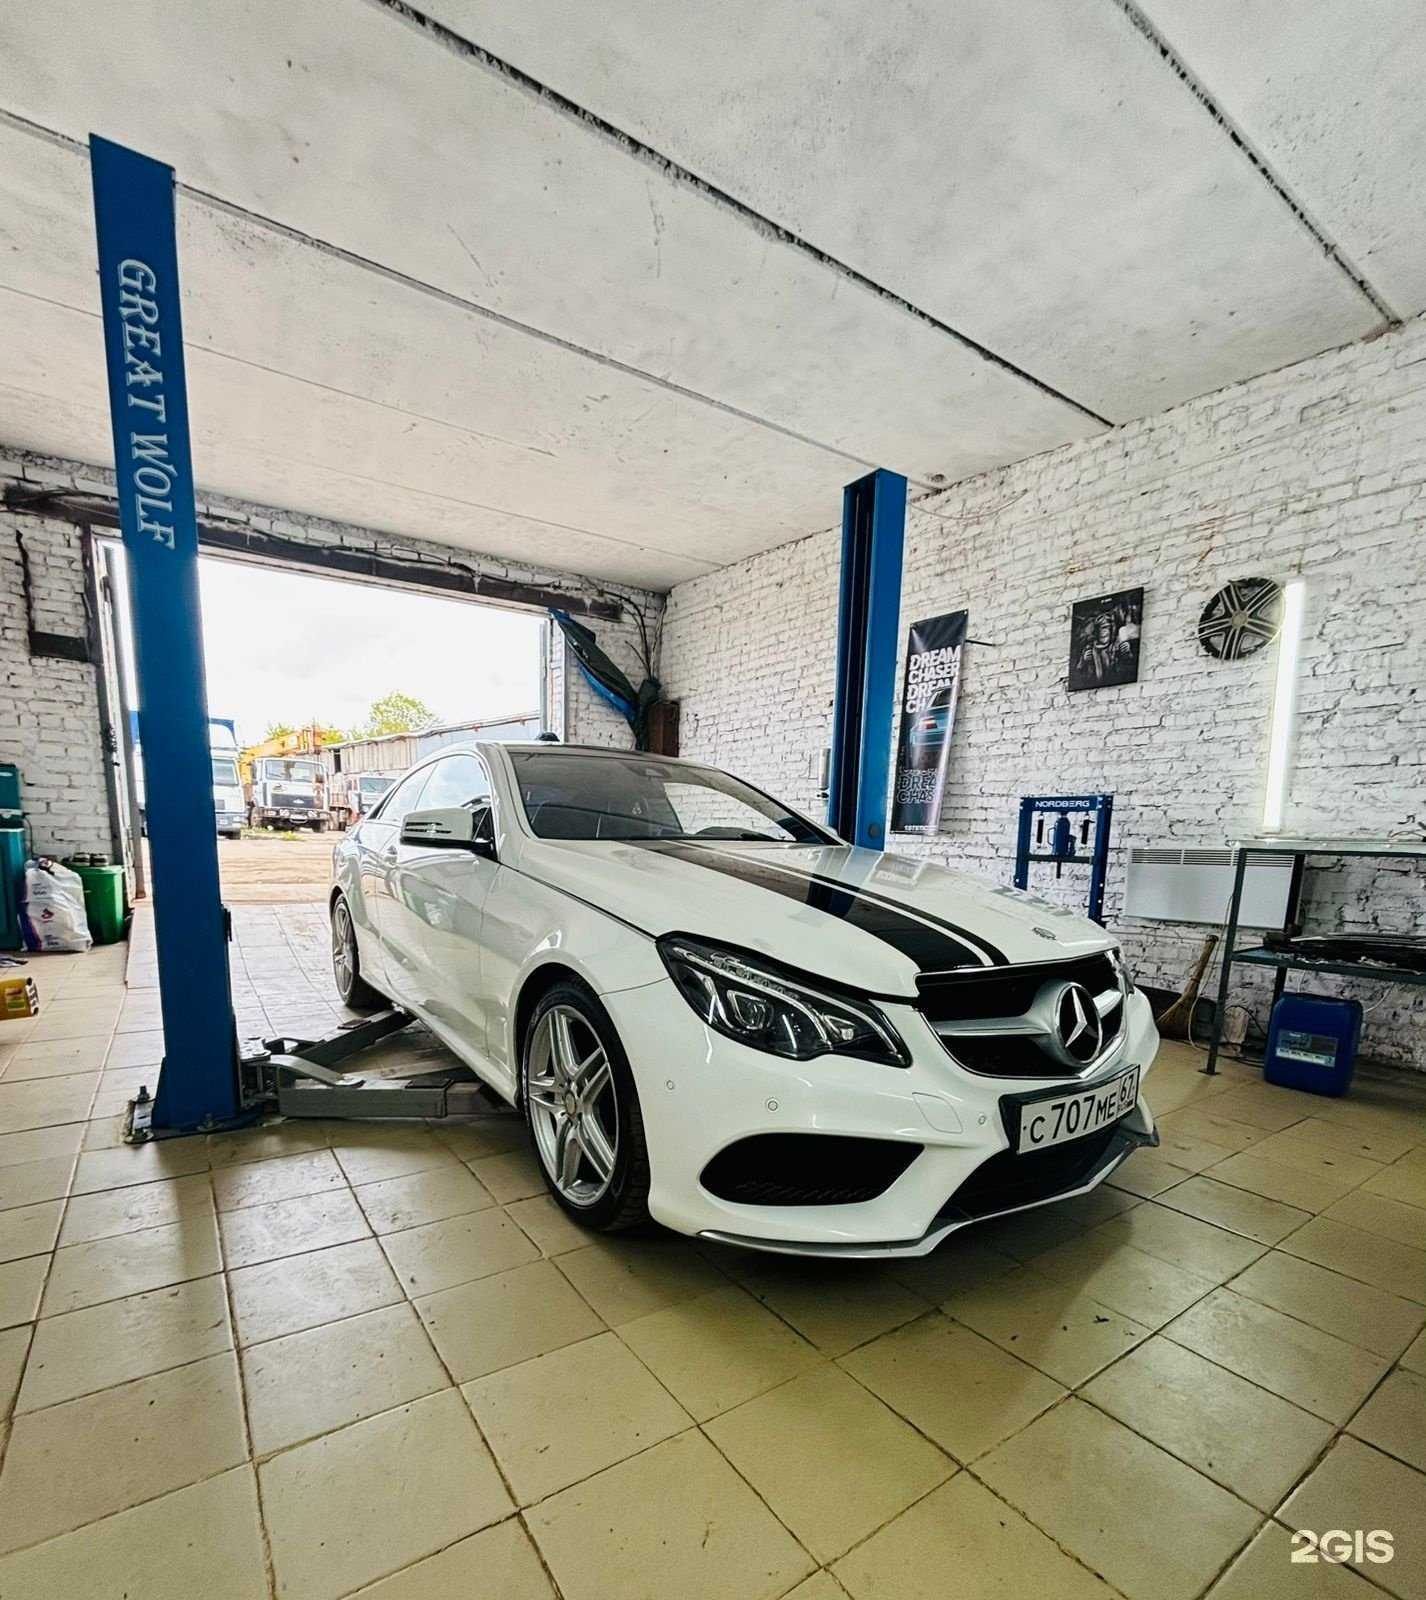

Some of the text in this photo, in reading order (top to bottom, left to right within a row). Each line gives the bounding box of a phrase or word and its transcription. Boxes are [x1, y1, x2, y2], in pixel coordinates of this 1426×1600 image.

[117, 258, 178, 550] GREAT WOLF
[909, 644, 961, 671] DREAM
[908, 661, 960, 684] CHASER
[1034, 800, 1090, 808] NORDBERG
